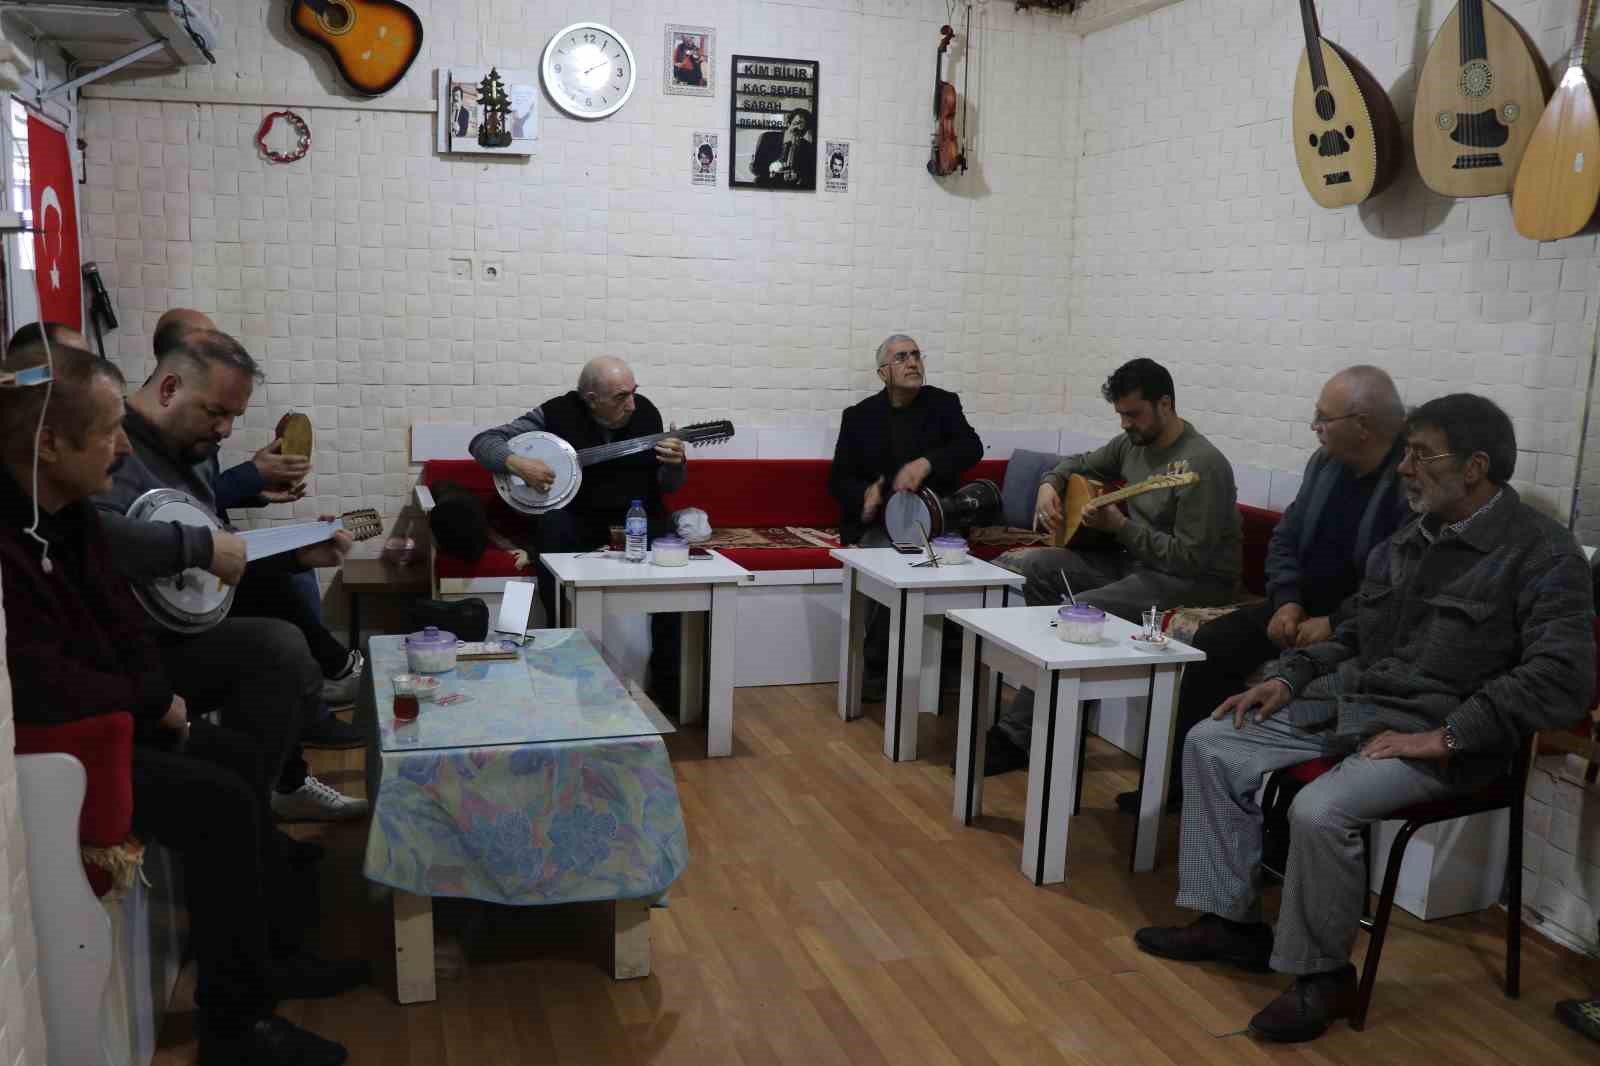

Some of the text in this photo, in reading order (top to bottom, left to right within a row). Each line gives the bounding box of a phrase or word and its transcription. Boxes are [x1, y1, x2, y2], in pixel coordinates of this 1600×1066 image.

[583, 33, 596, 43] 12
[554, 64, 562, 73] 9
[617, 67, 623, 78] 3
